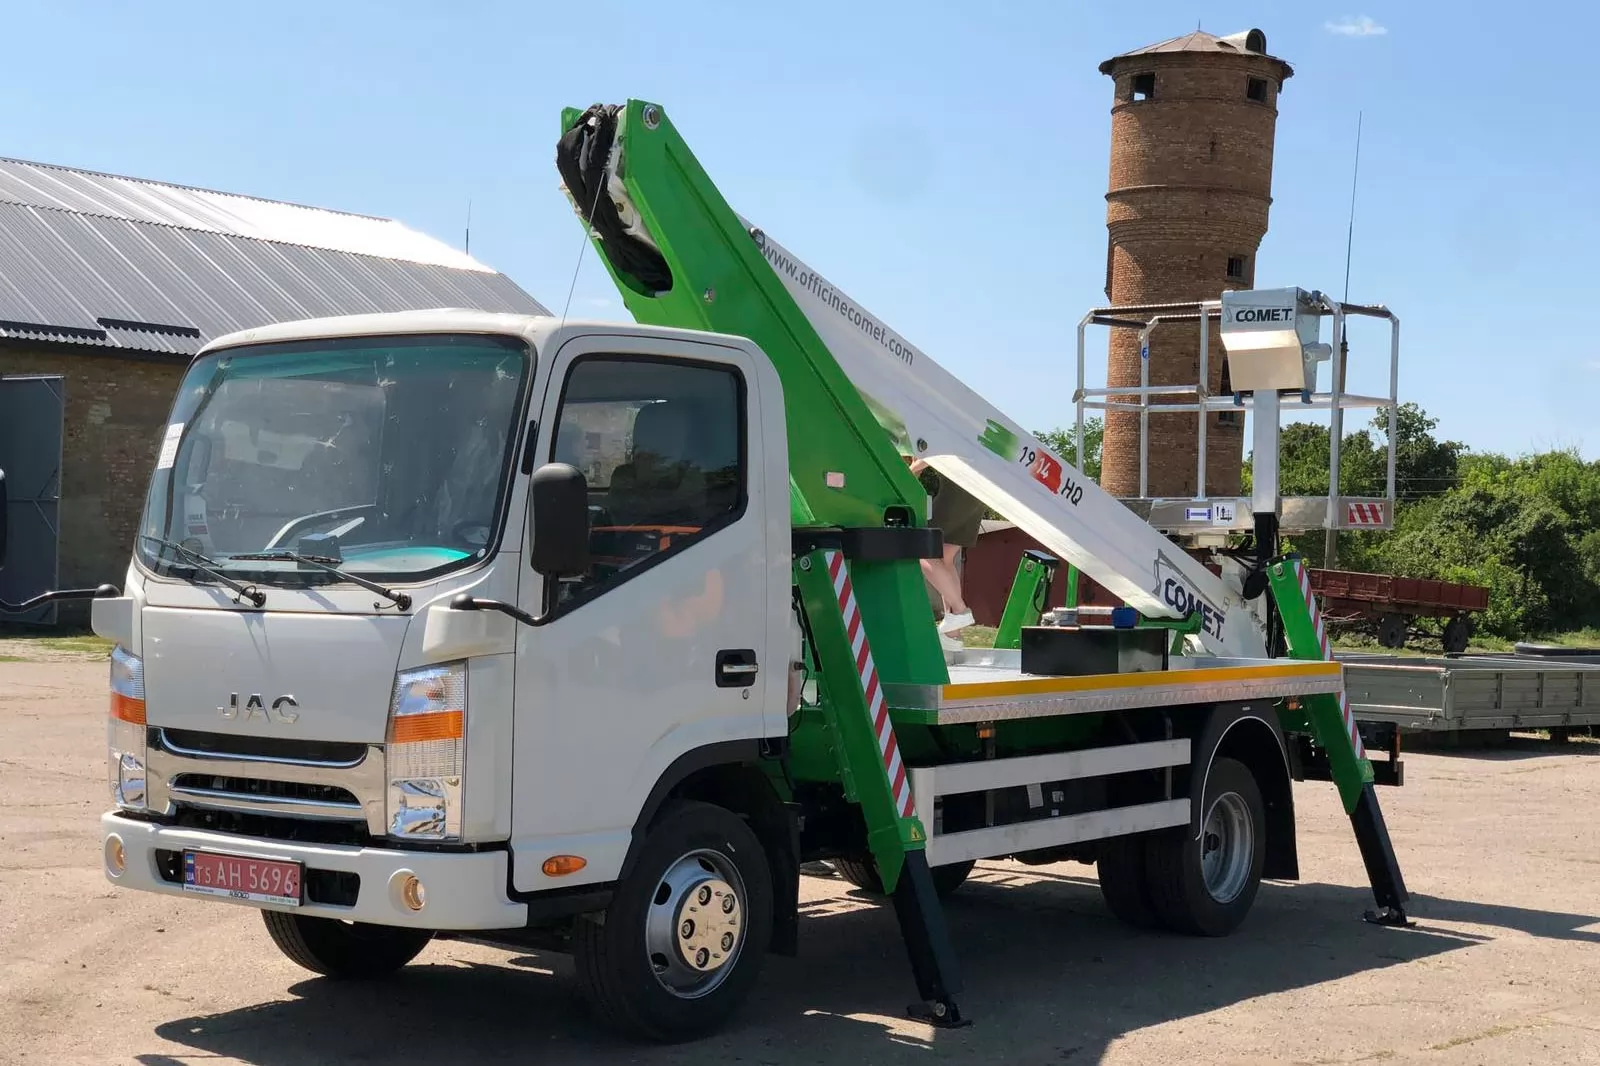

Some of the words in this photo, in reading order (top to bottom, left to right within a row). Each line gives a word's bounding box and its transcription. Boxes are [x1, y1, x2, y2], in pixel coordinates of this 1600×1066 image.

[763, 245, 914, 365] www.officinecomet.com
[1061, 477, 1083, 507] HQ
[216, 692, 299, 724] JAC
[186, 872, 195, 881] UA
[217, 861, 241, 887] AH
[249, 864, 293, 894] 5696
